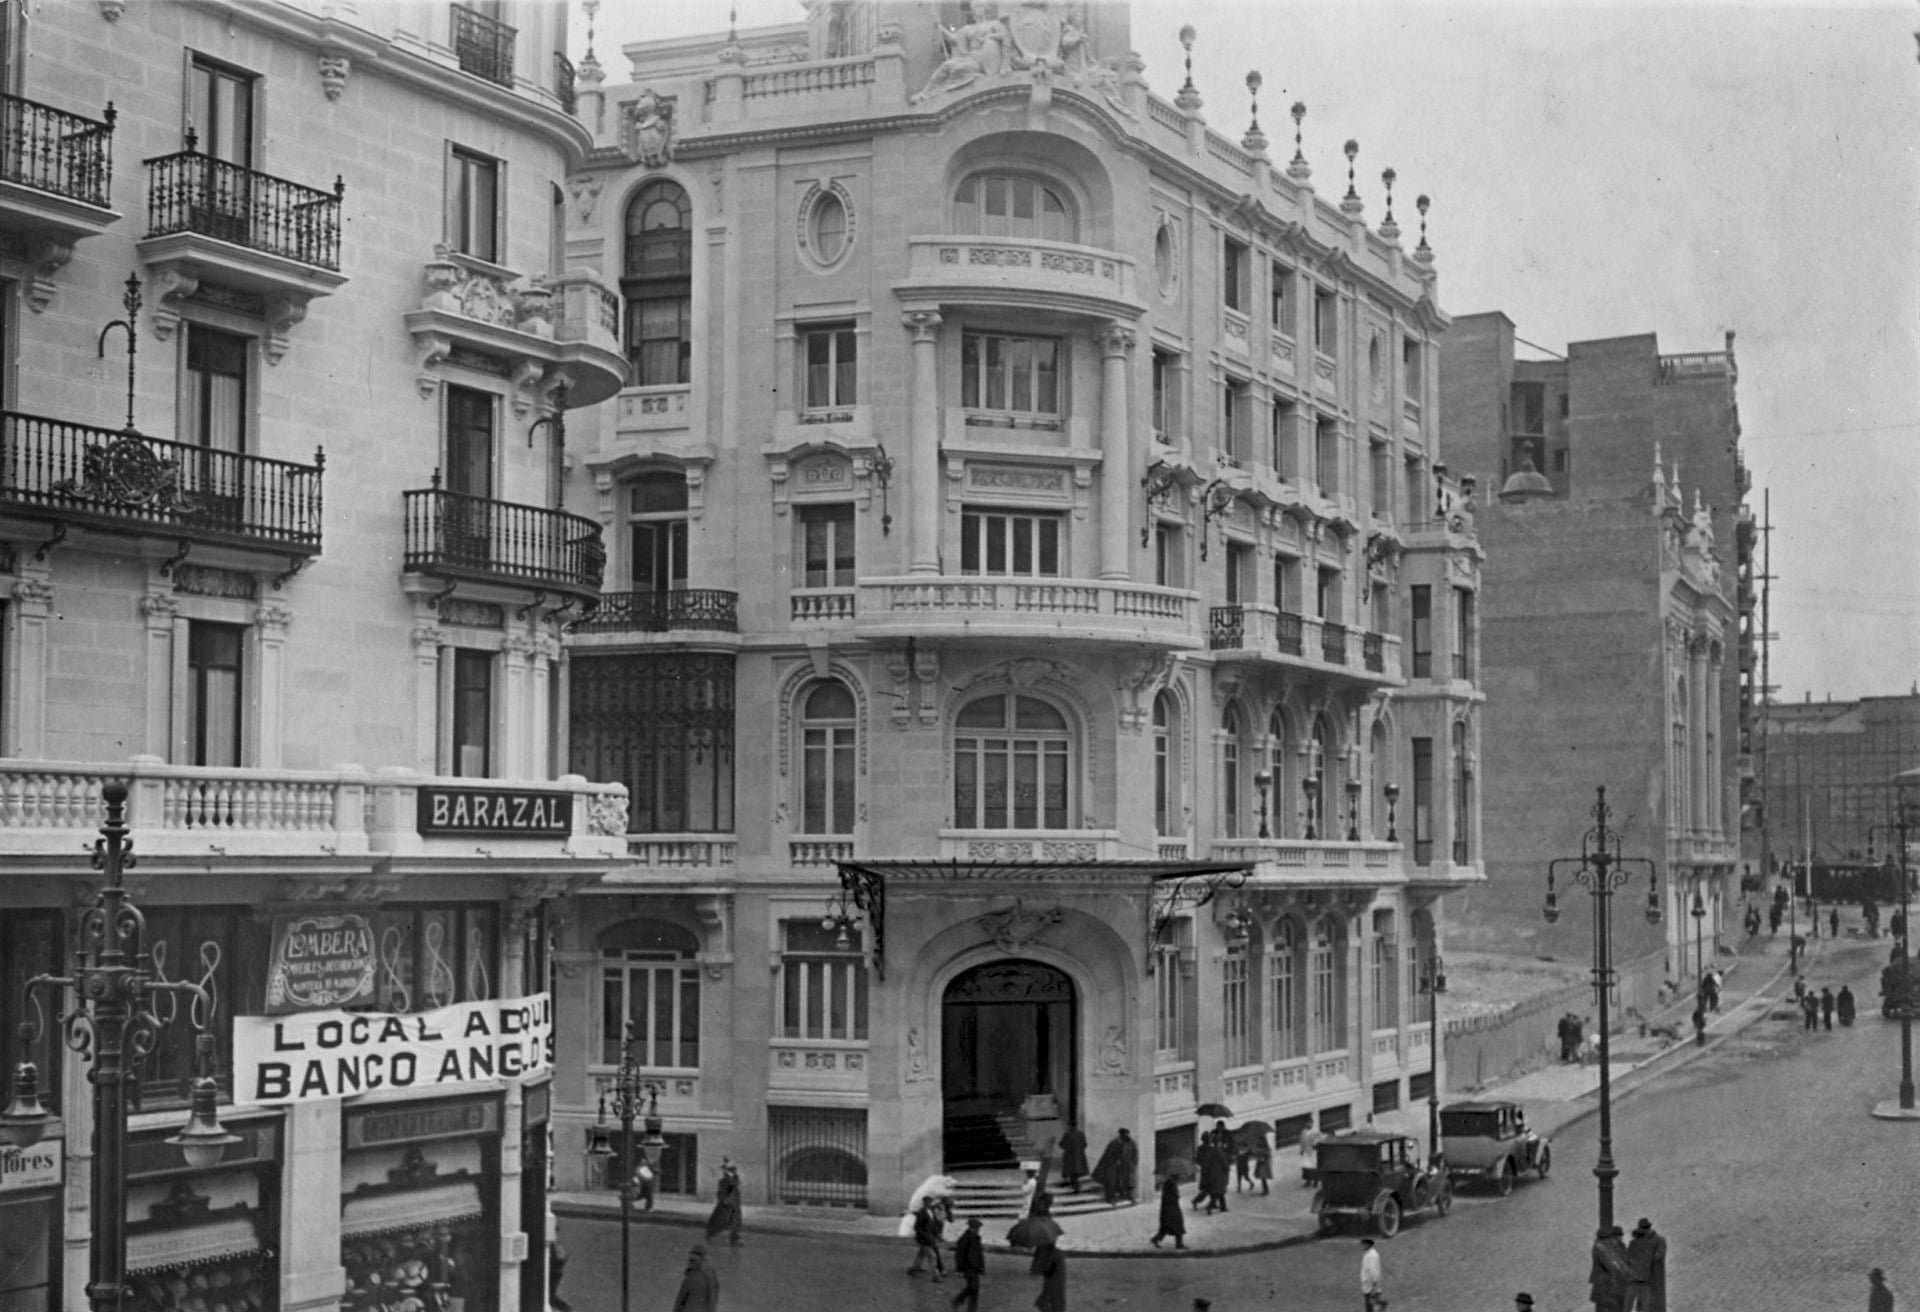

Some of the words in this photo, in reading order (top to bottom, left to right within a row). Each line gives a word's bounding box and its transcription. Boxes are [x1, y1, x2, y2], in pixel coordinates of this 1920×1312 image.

[432, 794, 565, 828] BARAZAL
[287, 929, 369, 958] LOMBERA
[273, 1016, 443, 1052] LOCAL
[256, 1051, 418, 1100] BANCO
